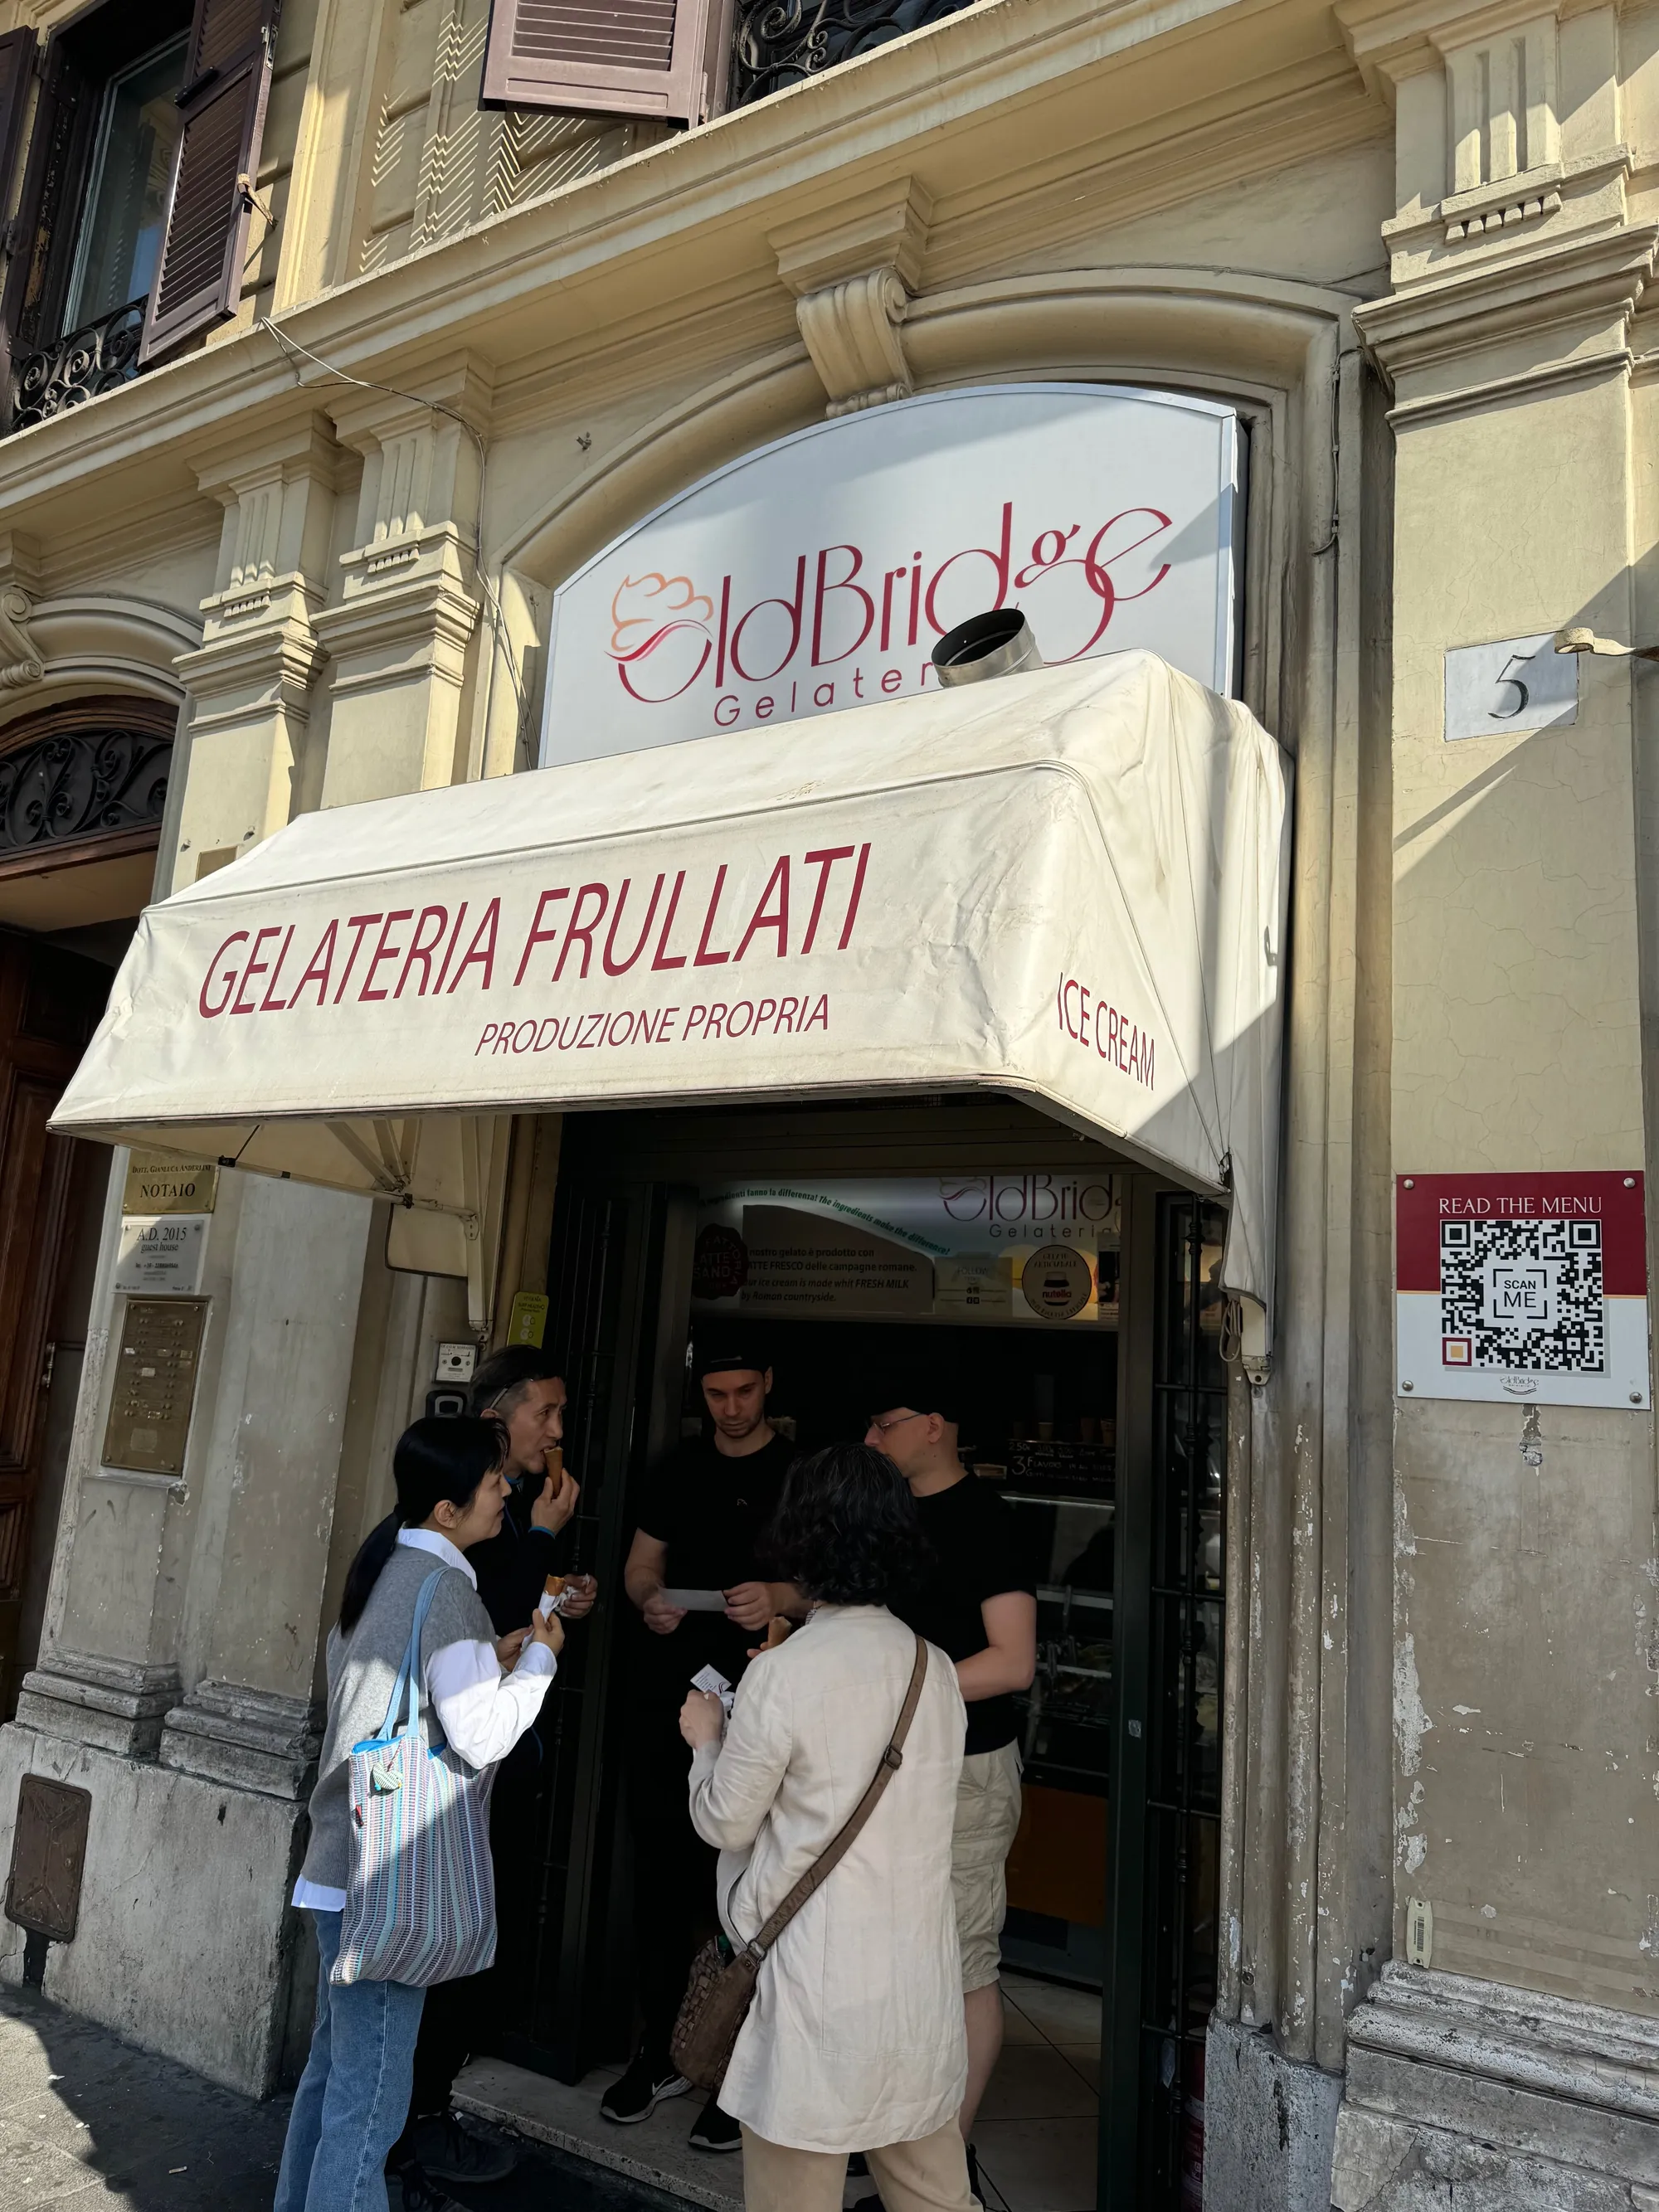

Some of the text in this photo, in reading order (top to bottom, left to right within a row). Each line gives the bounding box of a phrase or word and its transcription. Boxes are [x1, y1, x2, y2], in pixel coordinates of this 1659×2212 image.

[714, 660, 933, 727] Gelater
[1487, 654, 1535, 719] 5
[199, 843, 871, 1018] GELATERIA FRULLATI
[474, 994, 829, 1057] PRODUZIONE PROPRIA
[1058, 972, 1154, 1091] ICE CREAM
[139, 1183, 196, 1198] NOTAIO
[1439, 1197, 1602, 1214] READ THE MENU
[778, 1188, 818, 1202] differenza!
[819, 1195, 831, 1206] The
[832, 1199, 874, 1223] ingredients
[873, 1218, 894, 1232] make
[895, 1227, 907, 1237] the
[907, 1232, 951, 1256] difference!
[136, 1227, 187, 1241] A.D. 2015
[140, 1241, 179, 1254] guest house
[749, 1247, 777, 1257] nostro
[779, 1246, 806, 1258] gelato
[815, 1247, 856, 1258] prodotto
[695, 1252, 730, 1266] ATTE
[770, 1261, 803, 1271] FRESCO
[805, 1261, 827, 1271] delle
[829, 1263, 876, 1273] campagne
[878, 1263, 917, 1271] romane.
[758, 1278, 770, 1287] ice
[771, 1279, 797, 1287] cream
[800, 1278, 806, 1287] is
[808, 1278, 833, 1287] made
[834, 1279, 854, 1288] whit
[855, 1279, 884, 1288] FRESH
[886, 1279, 910, 1289] MILK
[1504, 1280, 1536, 1290] SCAN
[741, 1291, 836, 1303] by Roman countryside.
[1043, 1288, 1073, 1300] nutella
[1504, 1291, 1536, 1307] ME
[1011, 1456, 1026, 1475] 3
